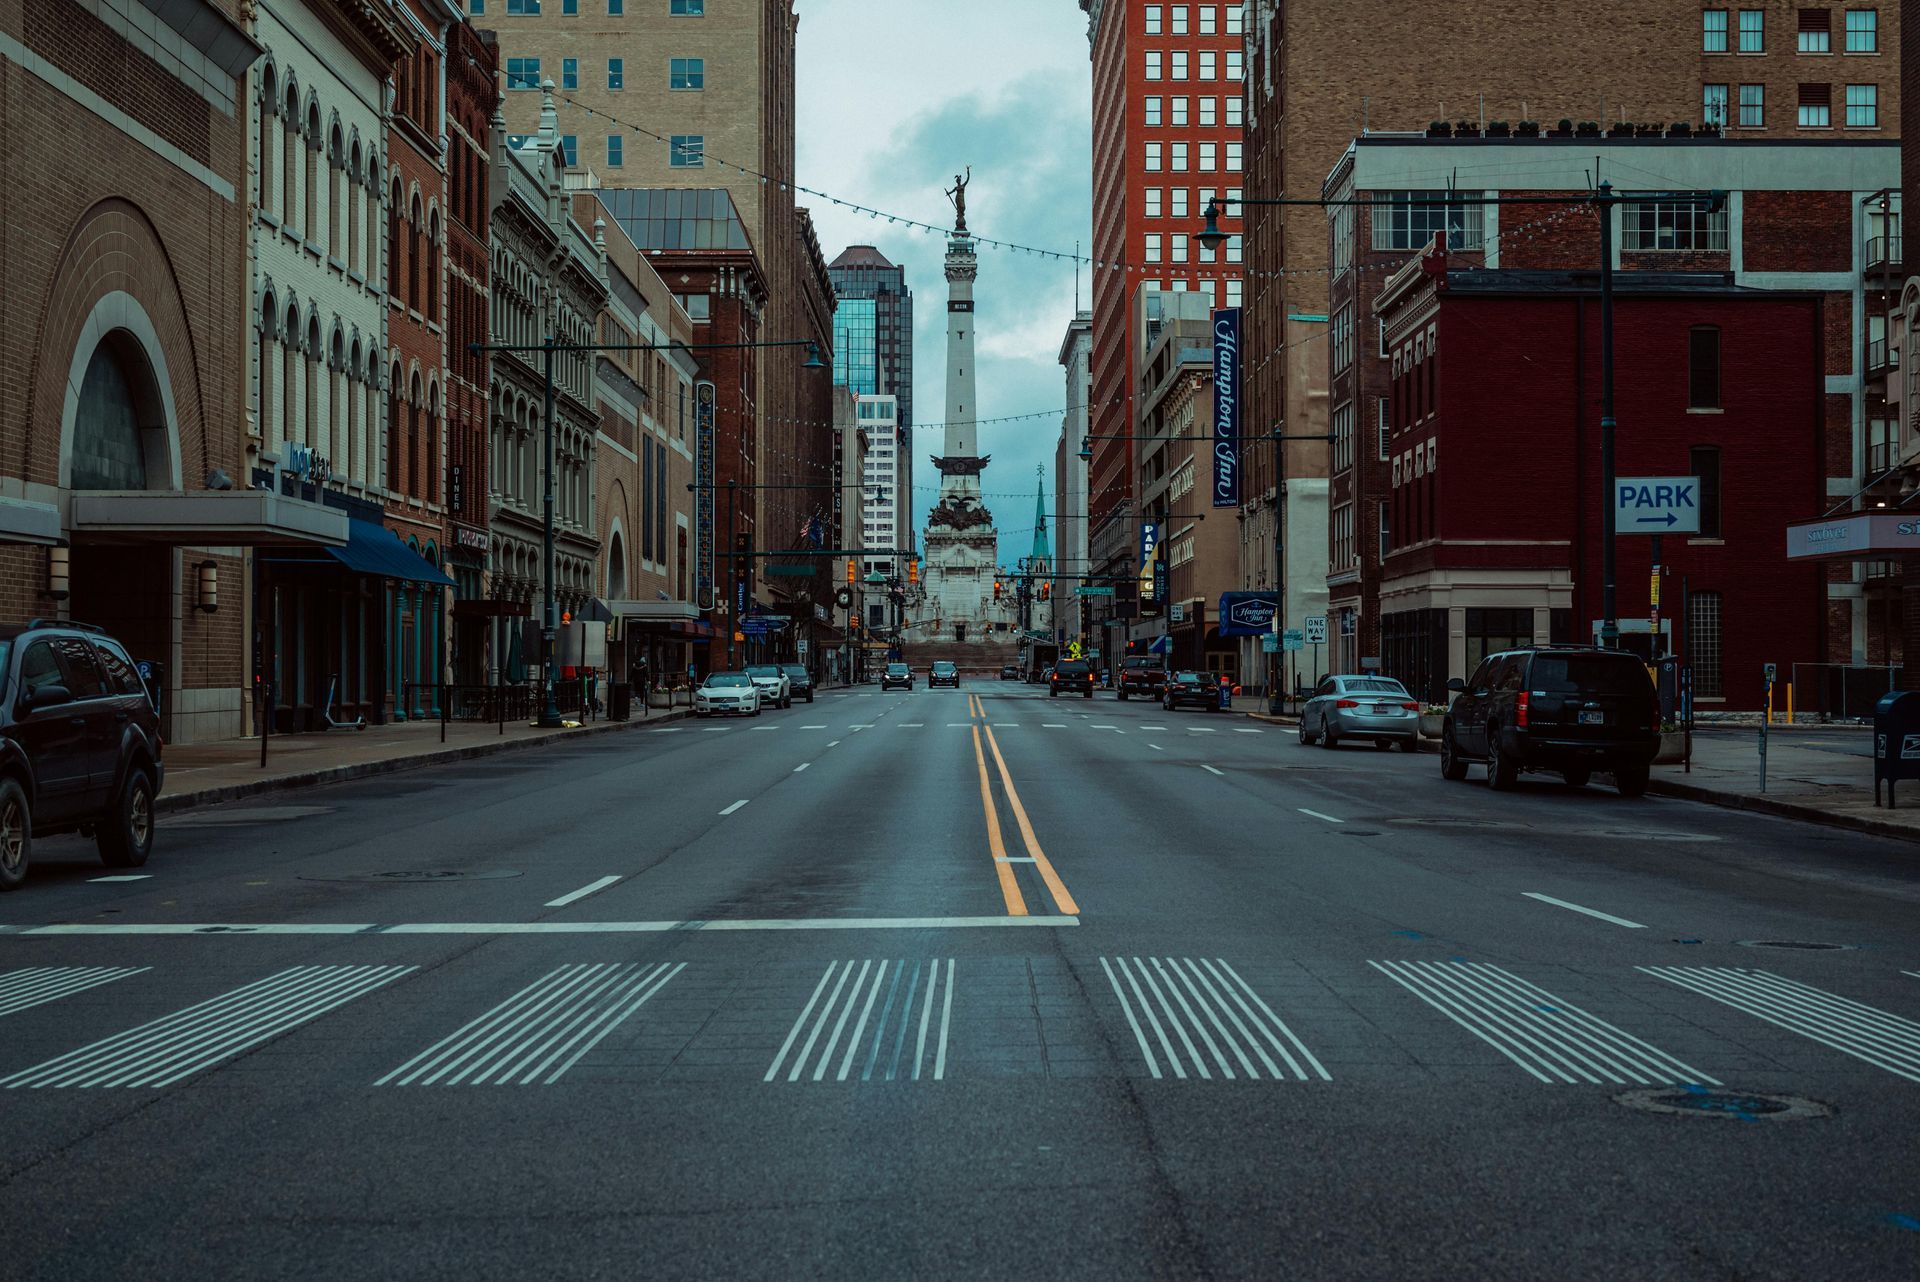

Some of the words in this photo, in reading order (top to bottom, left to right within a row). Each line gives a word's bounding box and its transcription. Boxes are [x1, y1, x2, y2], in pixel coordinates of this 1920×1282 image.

[1215, 319, 1236, 437] Hampton
[290, 441, 330, 481] IndyStar
[1215, 442, 1236, 497] Inn
[453, 466, 461, 511] DINER
[1620, 485, 1695, 508] PARK
[1236, 607, 1275, 617] Hampton
[1308, 619, 1324, 627] ONE
